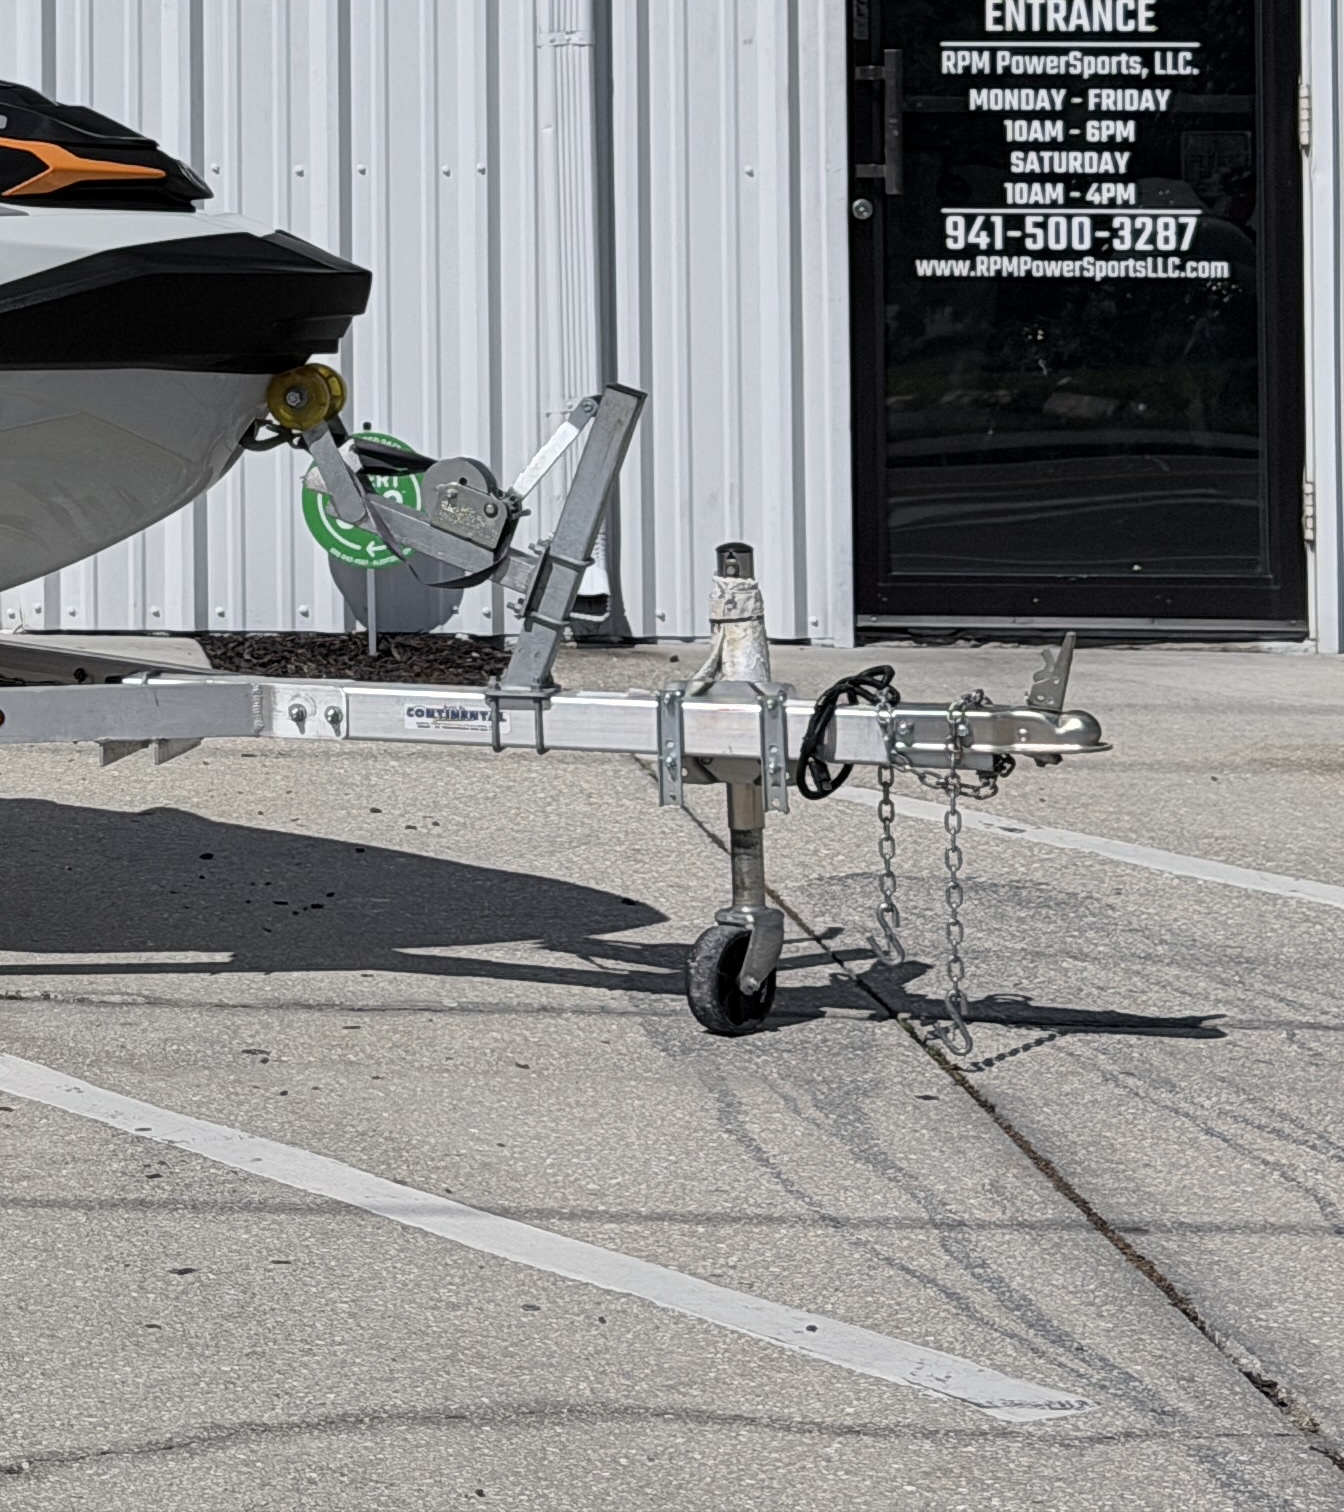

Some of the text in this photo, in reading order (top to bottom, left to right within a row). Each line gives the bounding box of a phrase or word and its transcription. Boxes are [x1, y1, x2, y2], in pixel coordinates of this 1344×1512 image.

[941, 50, 1200, 79] RPM PowerSports, LLC.
[968, 88, 1067, 111] MONDAY
[1087, 88, 1172, 111] FRIDAY
[1003, 119, 1064, 142] 10AM
[1085, 119, 1136, 142] 6PM
[1010, 151, 1131, 174] SATURDAY
[1003, 182, 1064, 205] 10AM
[1085, 182, 1136, 205] 4PM
[945, 215, 1198, 251] 941-500-3287
[915, 256, 1230, 281] www.RPMPowerSportsLLC.com
